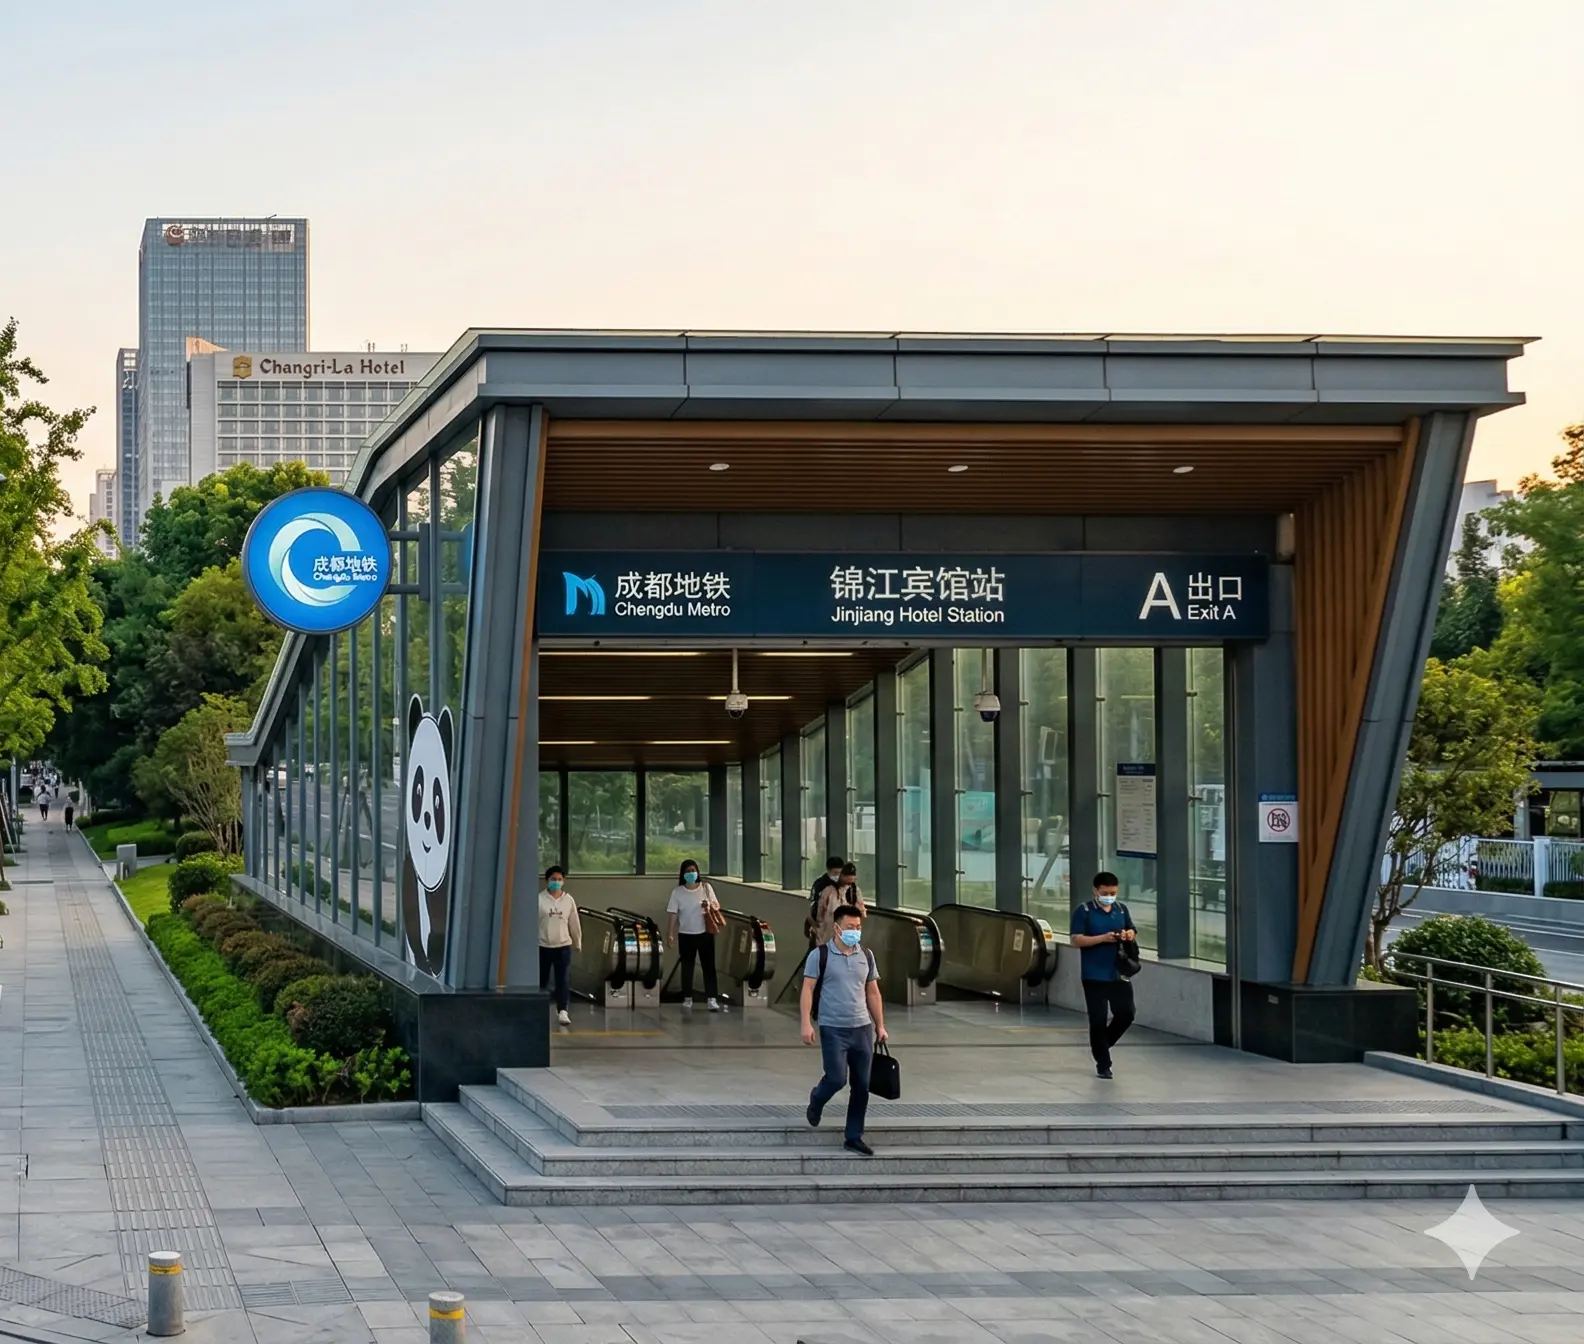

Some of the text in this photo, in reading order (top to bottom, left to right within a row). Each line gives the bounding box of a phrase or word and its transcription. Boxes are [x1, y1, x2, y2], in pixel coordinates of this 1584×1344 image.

[259, 358, 405, 379] Changri-La Hotel
[615, 571, 731, 600] 成都地铁
[829, 566, 1005, 601] 锦江宾馆站
[1138, 572, 1182, 619] A
[1188, 572, 1242, 601] 出口
[615, 602, 731, 619] Chengdu Metro
[831, 606, 1005, 626] Jinjiang Hotel Station
[1187, 604, 1237, 620] Exit A
